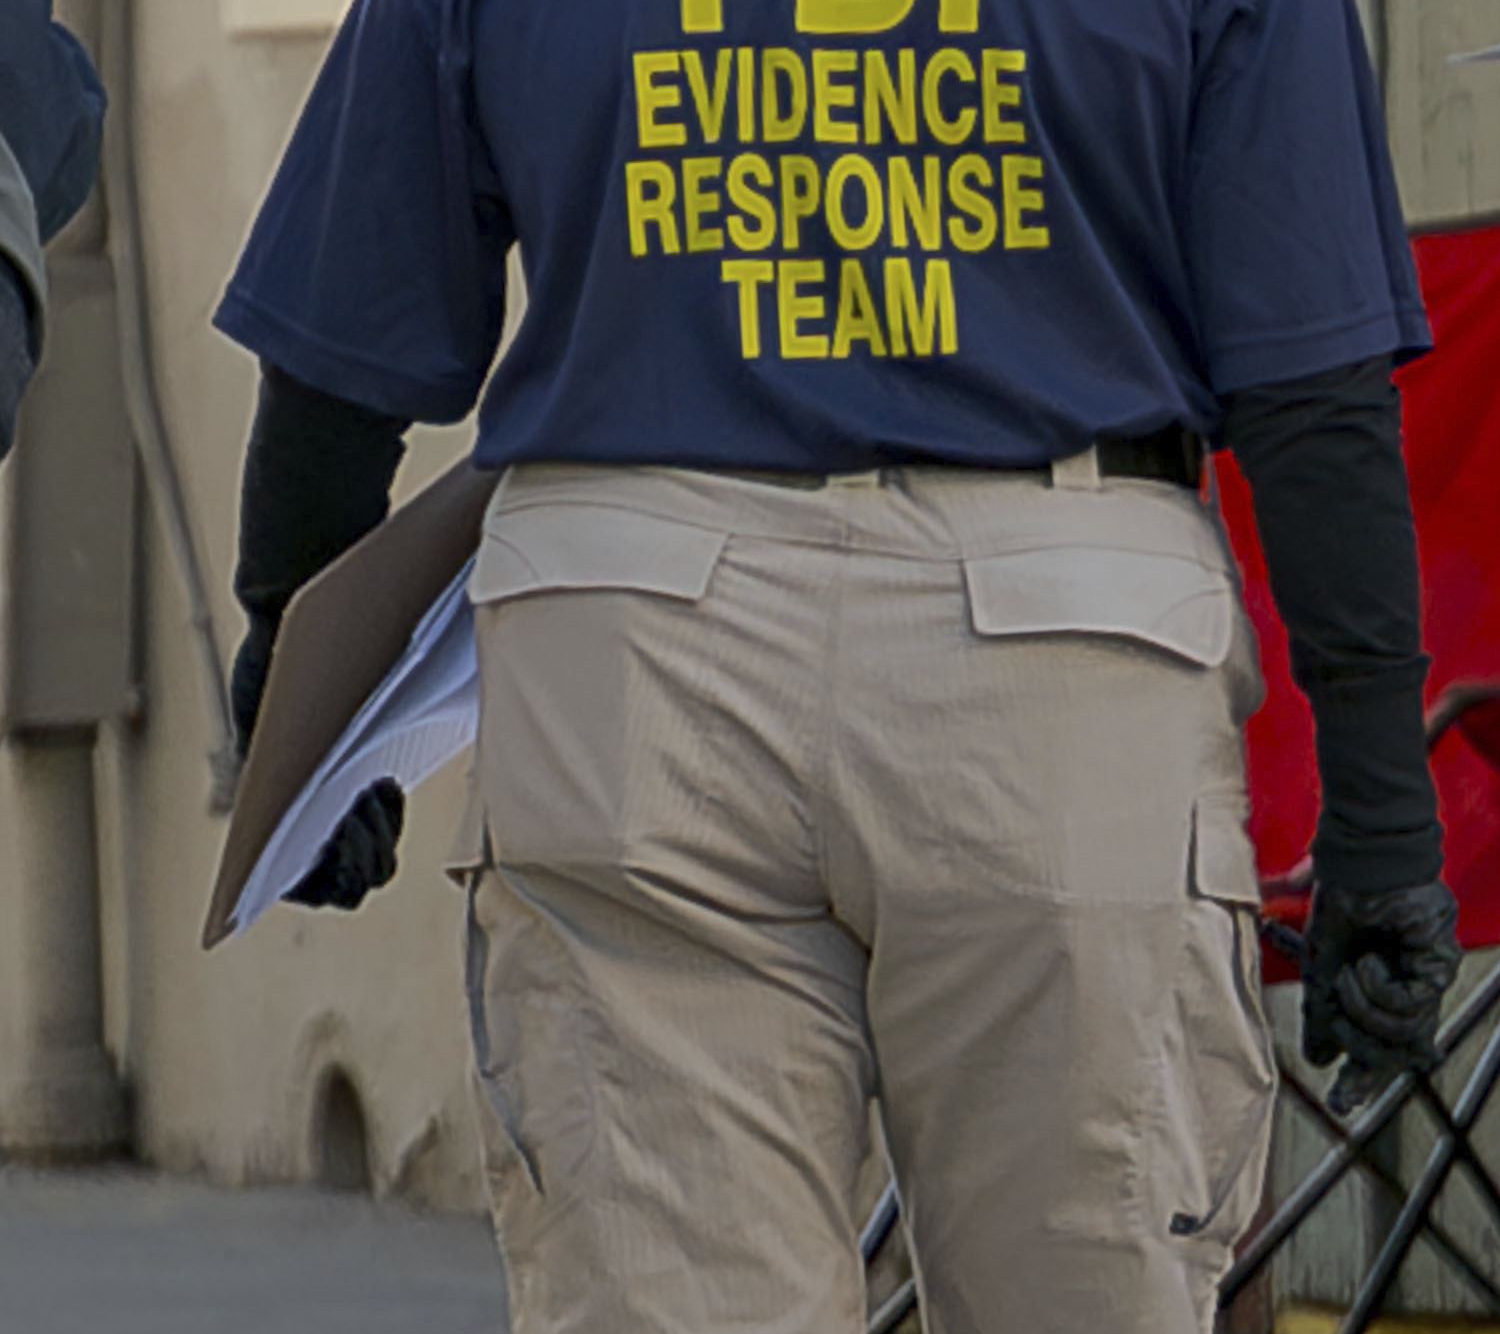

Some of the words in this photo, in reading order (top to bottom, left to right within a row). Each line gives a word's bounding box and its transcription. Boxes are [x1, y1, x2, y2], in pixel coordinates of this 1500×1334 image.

[633, 47, 1027, 149] EVIDENCE
[624, 153, 1051, 257] RESPONSE
[721, 257, 959, 360] TEAM
